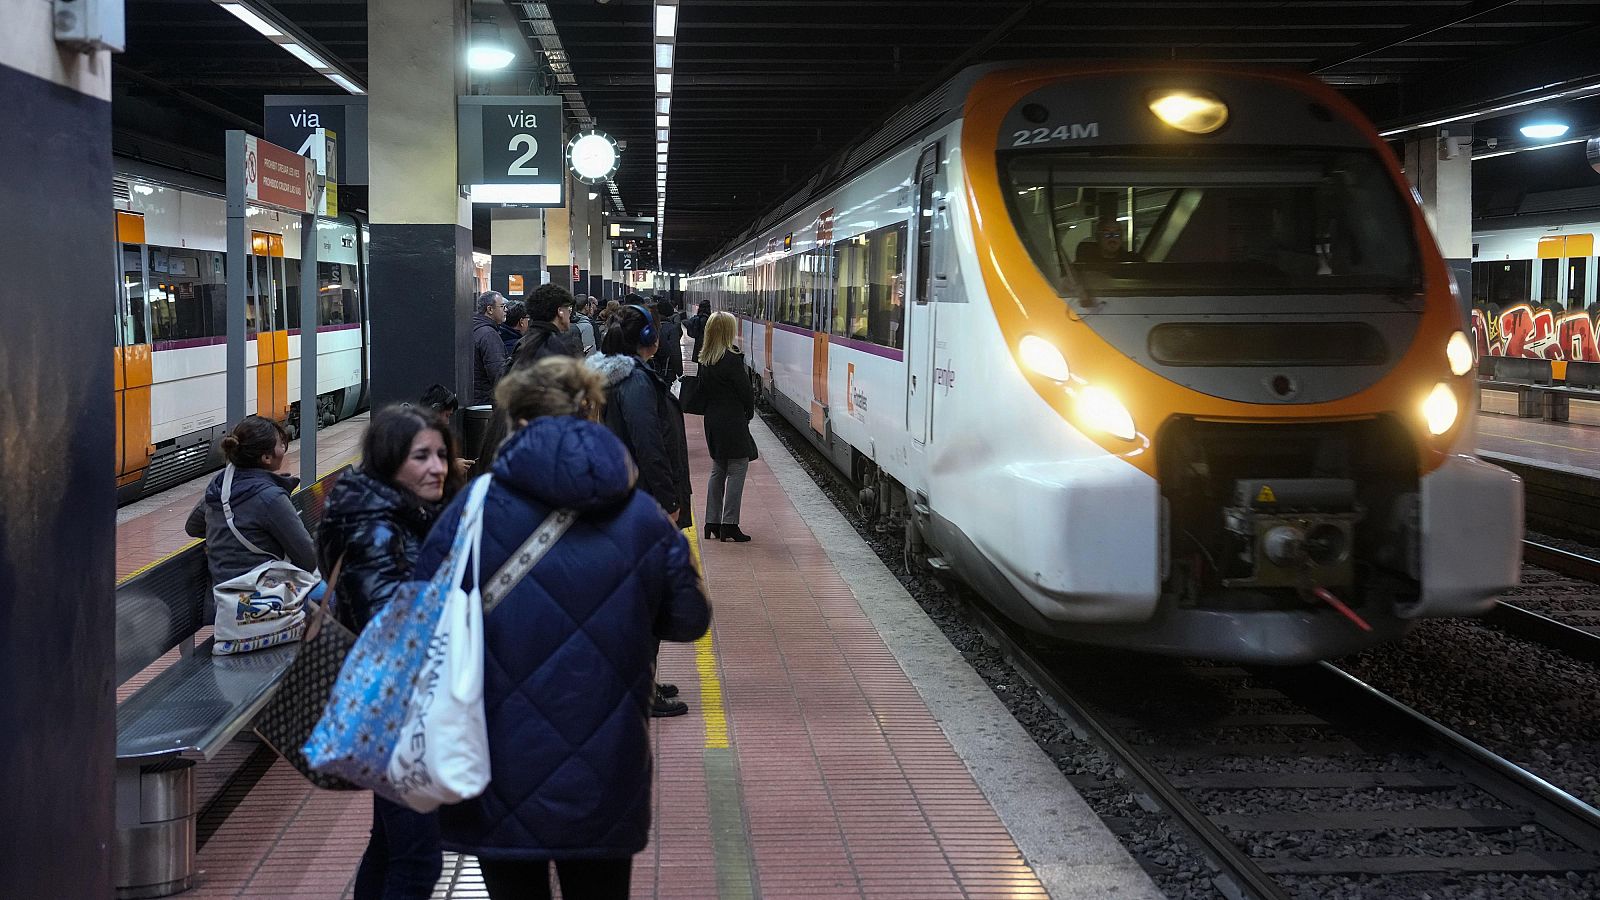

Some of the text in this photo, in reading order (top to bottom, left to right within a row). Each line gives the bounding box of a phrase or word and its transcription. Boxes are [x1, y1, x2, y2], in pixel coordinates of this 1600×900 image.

[290, 109, 320, 128] via
[507, 109, 538, 128] via
[1012, 122, 1099, 147] 224M
[507, 133, 539, 176] 2
[624, 258, 632, 270] 2
